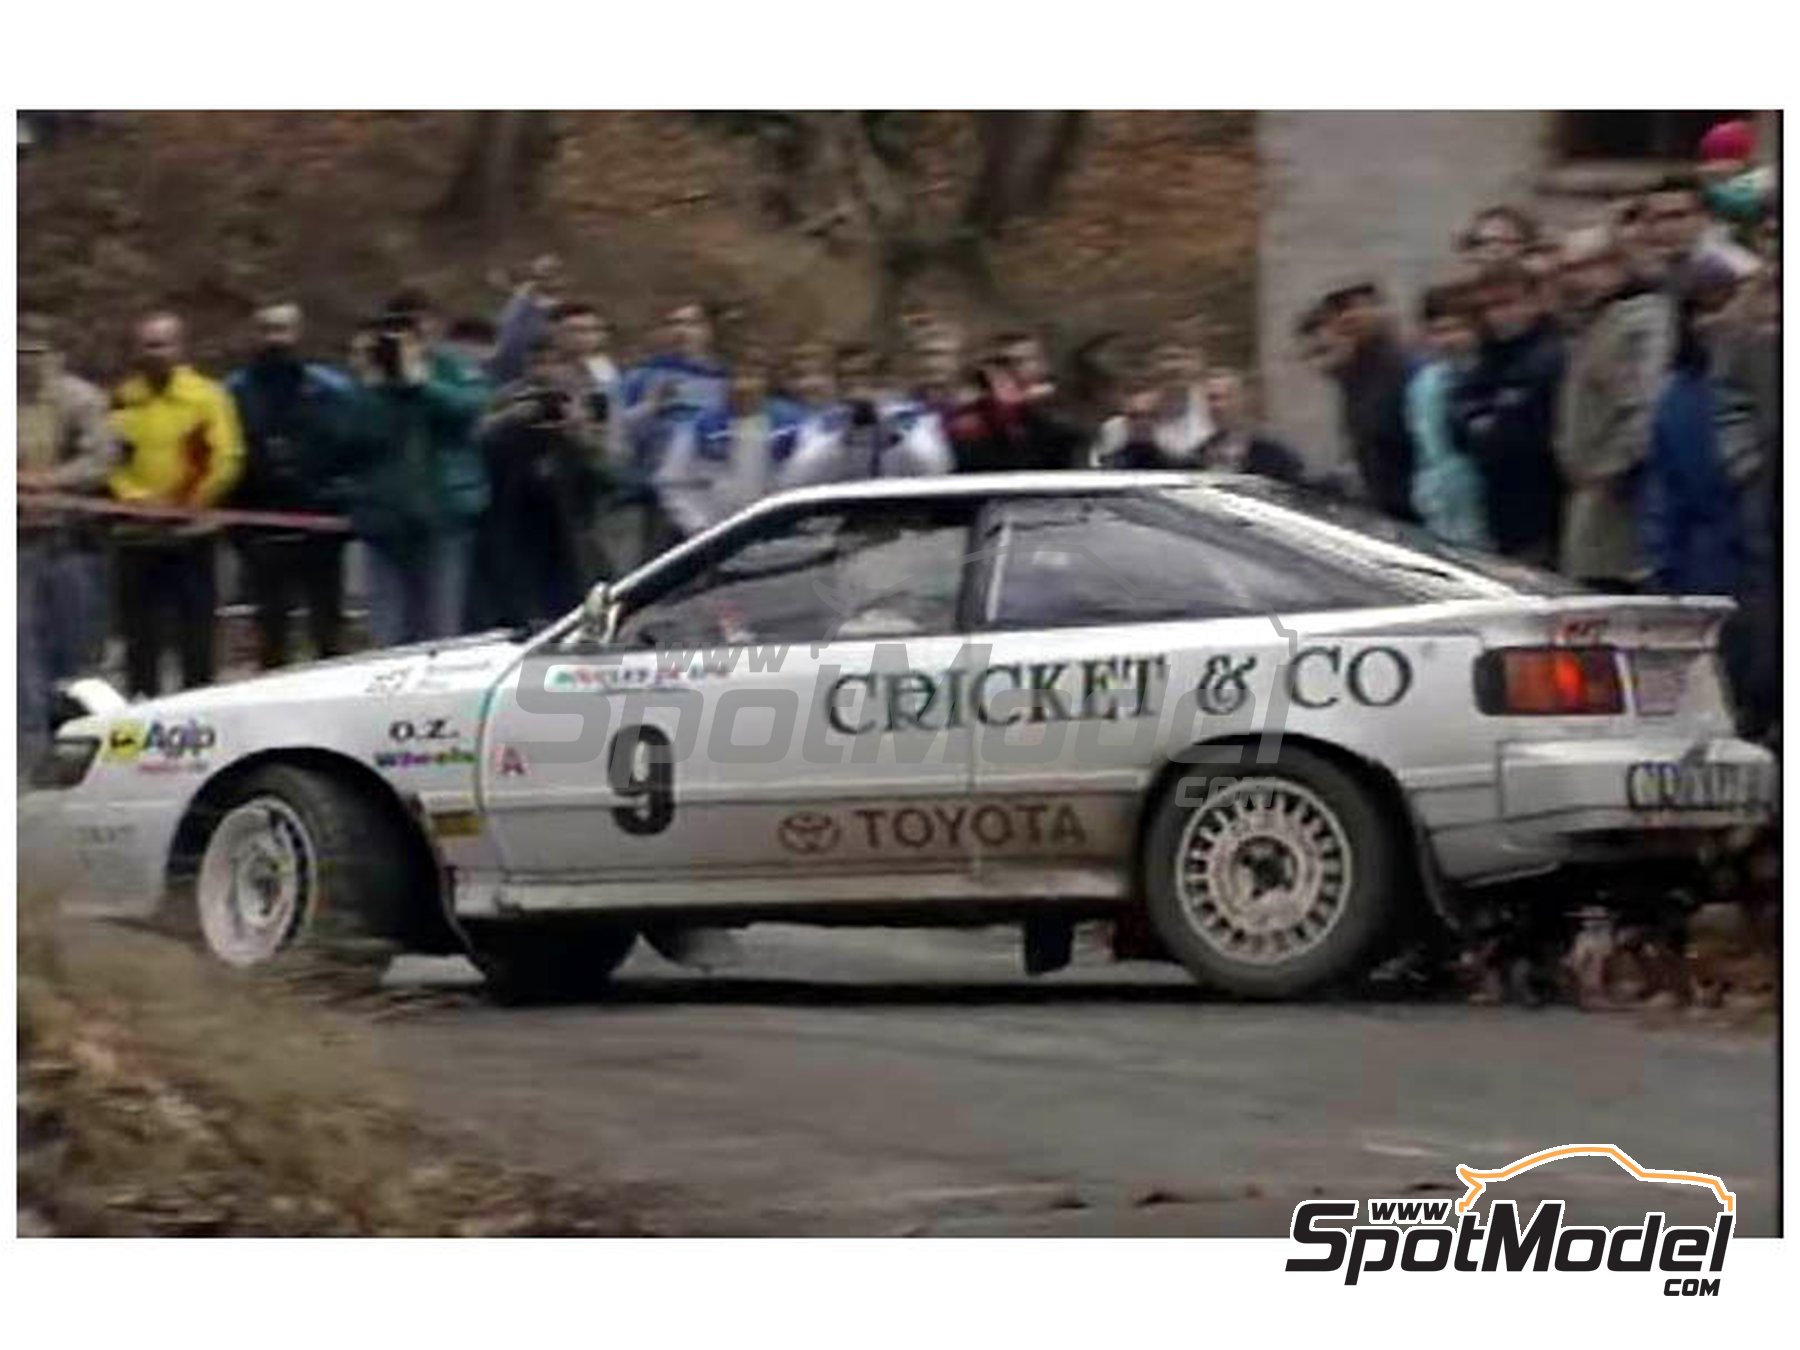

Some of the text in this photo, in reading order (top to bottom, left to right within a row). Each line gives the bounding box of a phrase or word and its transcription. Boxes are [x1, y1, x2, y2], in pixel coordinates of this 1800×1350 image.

[825, 645, 1413, 736] CRICKET & CO
[608, 725, 675, 836] 9
[855, 804, 1086, 848] TOYOTA
